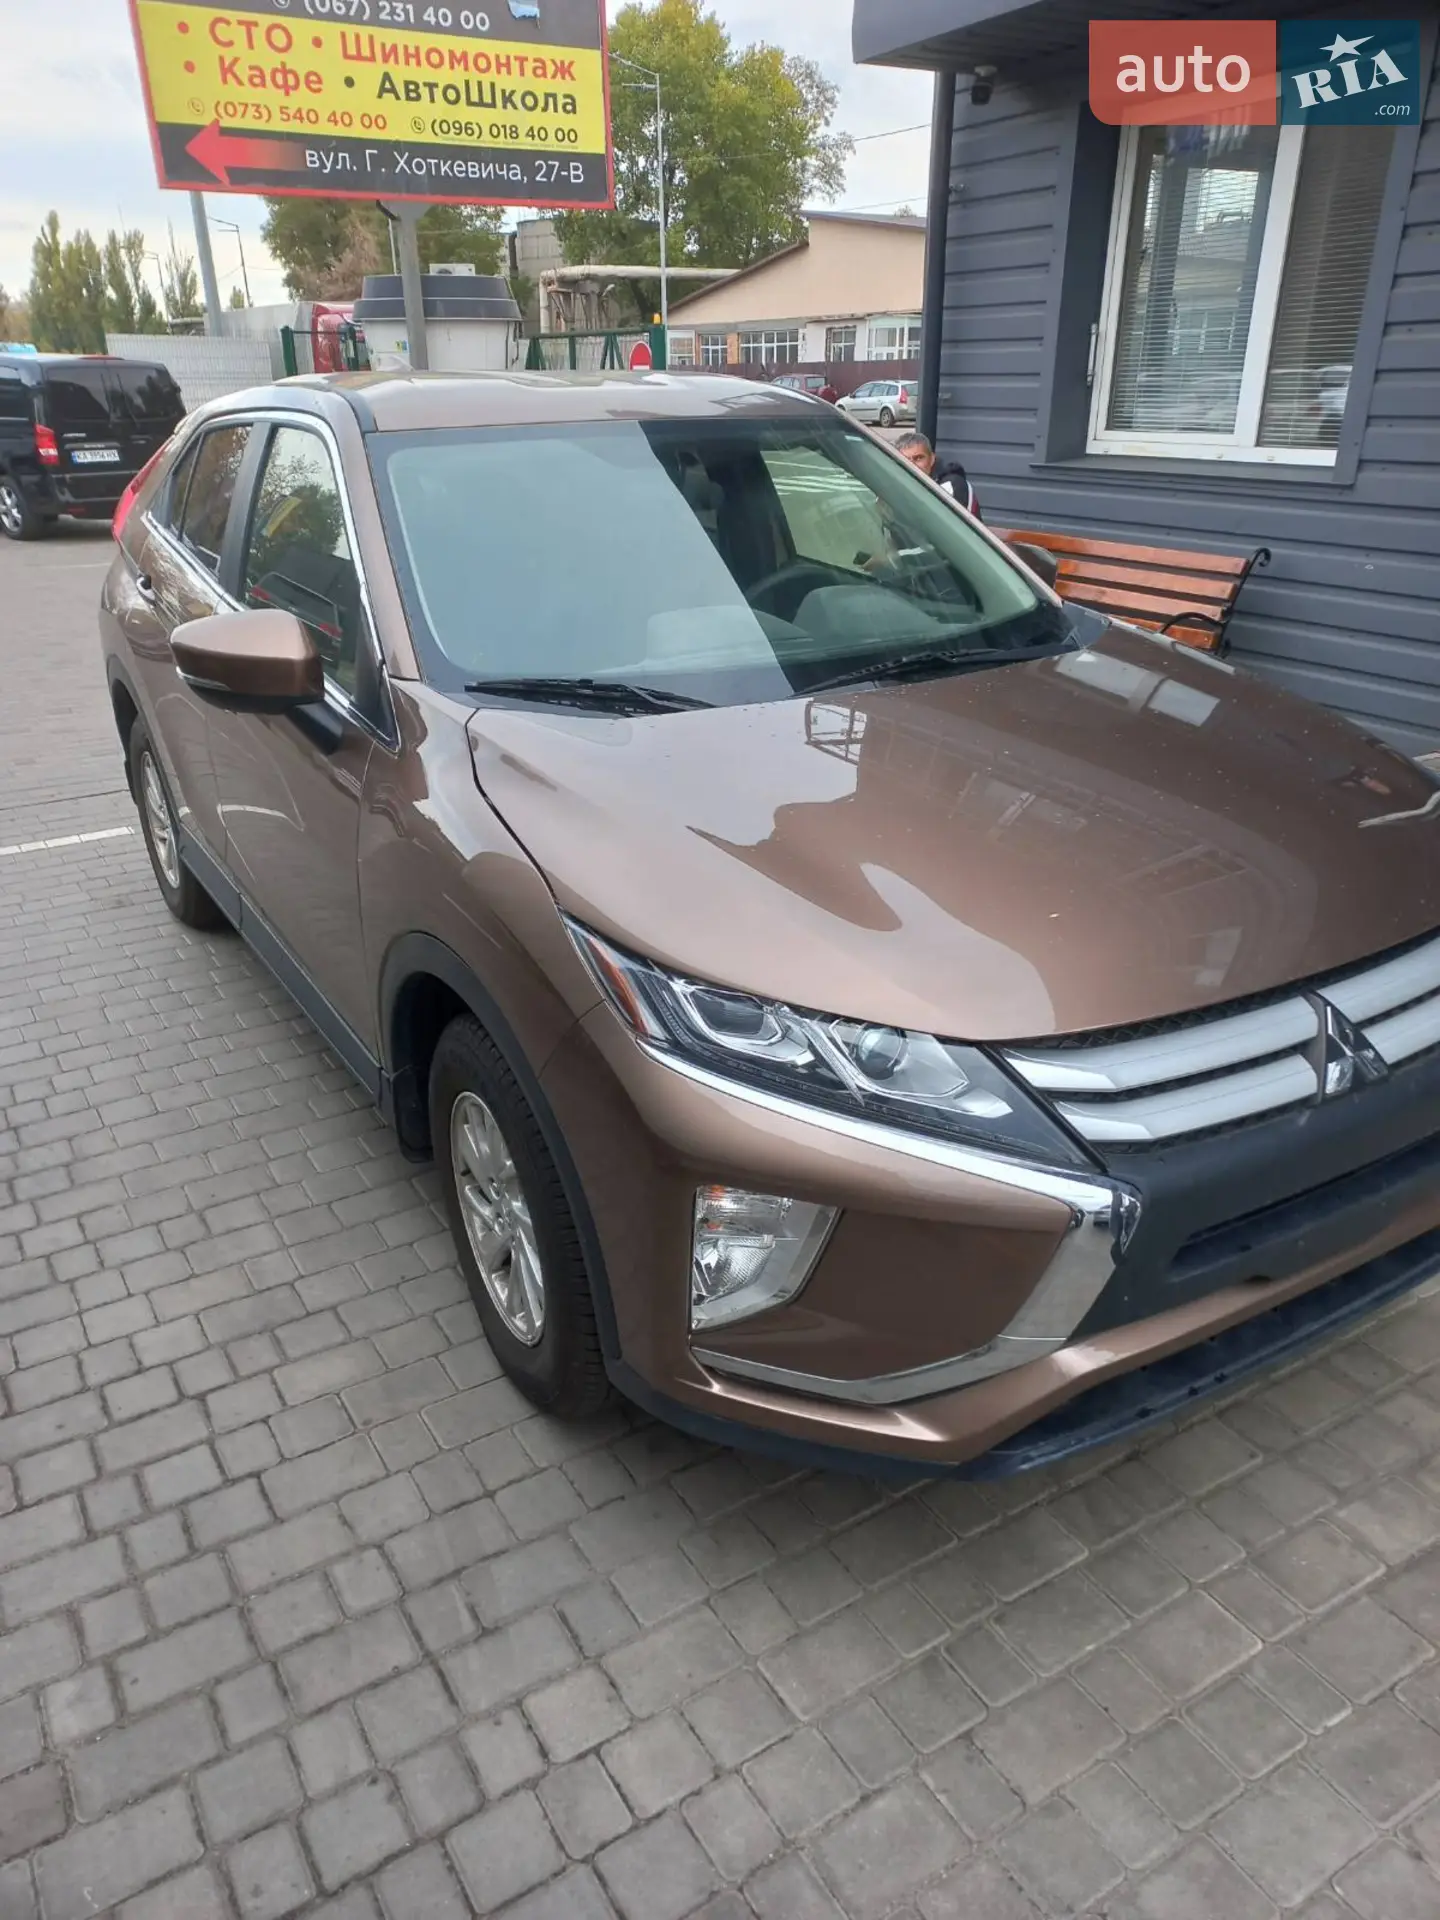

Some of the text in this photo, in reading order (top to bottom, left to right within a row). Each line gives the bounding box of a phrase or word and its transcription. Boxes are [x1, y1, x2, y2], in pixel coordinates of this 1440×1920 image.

[304, 0, 490, 31] (067) 231 40 00
[209, 17, 577, 81] СТО Шиномонтаж
[218, 55, 577, 115] Кафе АвтоШкола
[214, 100, 387, 130] (073) 540 40 00
[431, 118, 483, 139] (096)
[489, 123, 519, 140] 018
[525, 126, 548, 142] 40
[554, 128, 578, 143] 00
[306, 149, 585, 184] вул. Г. Хоткевича, 27-В
